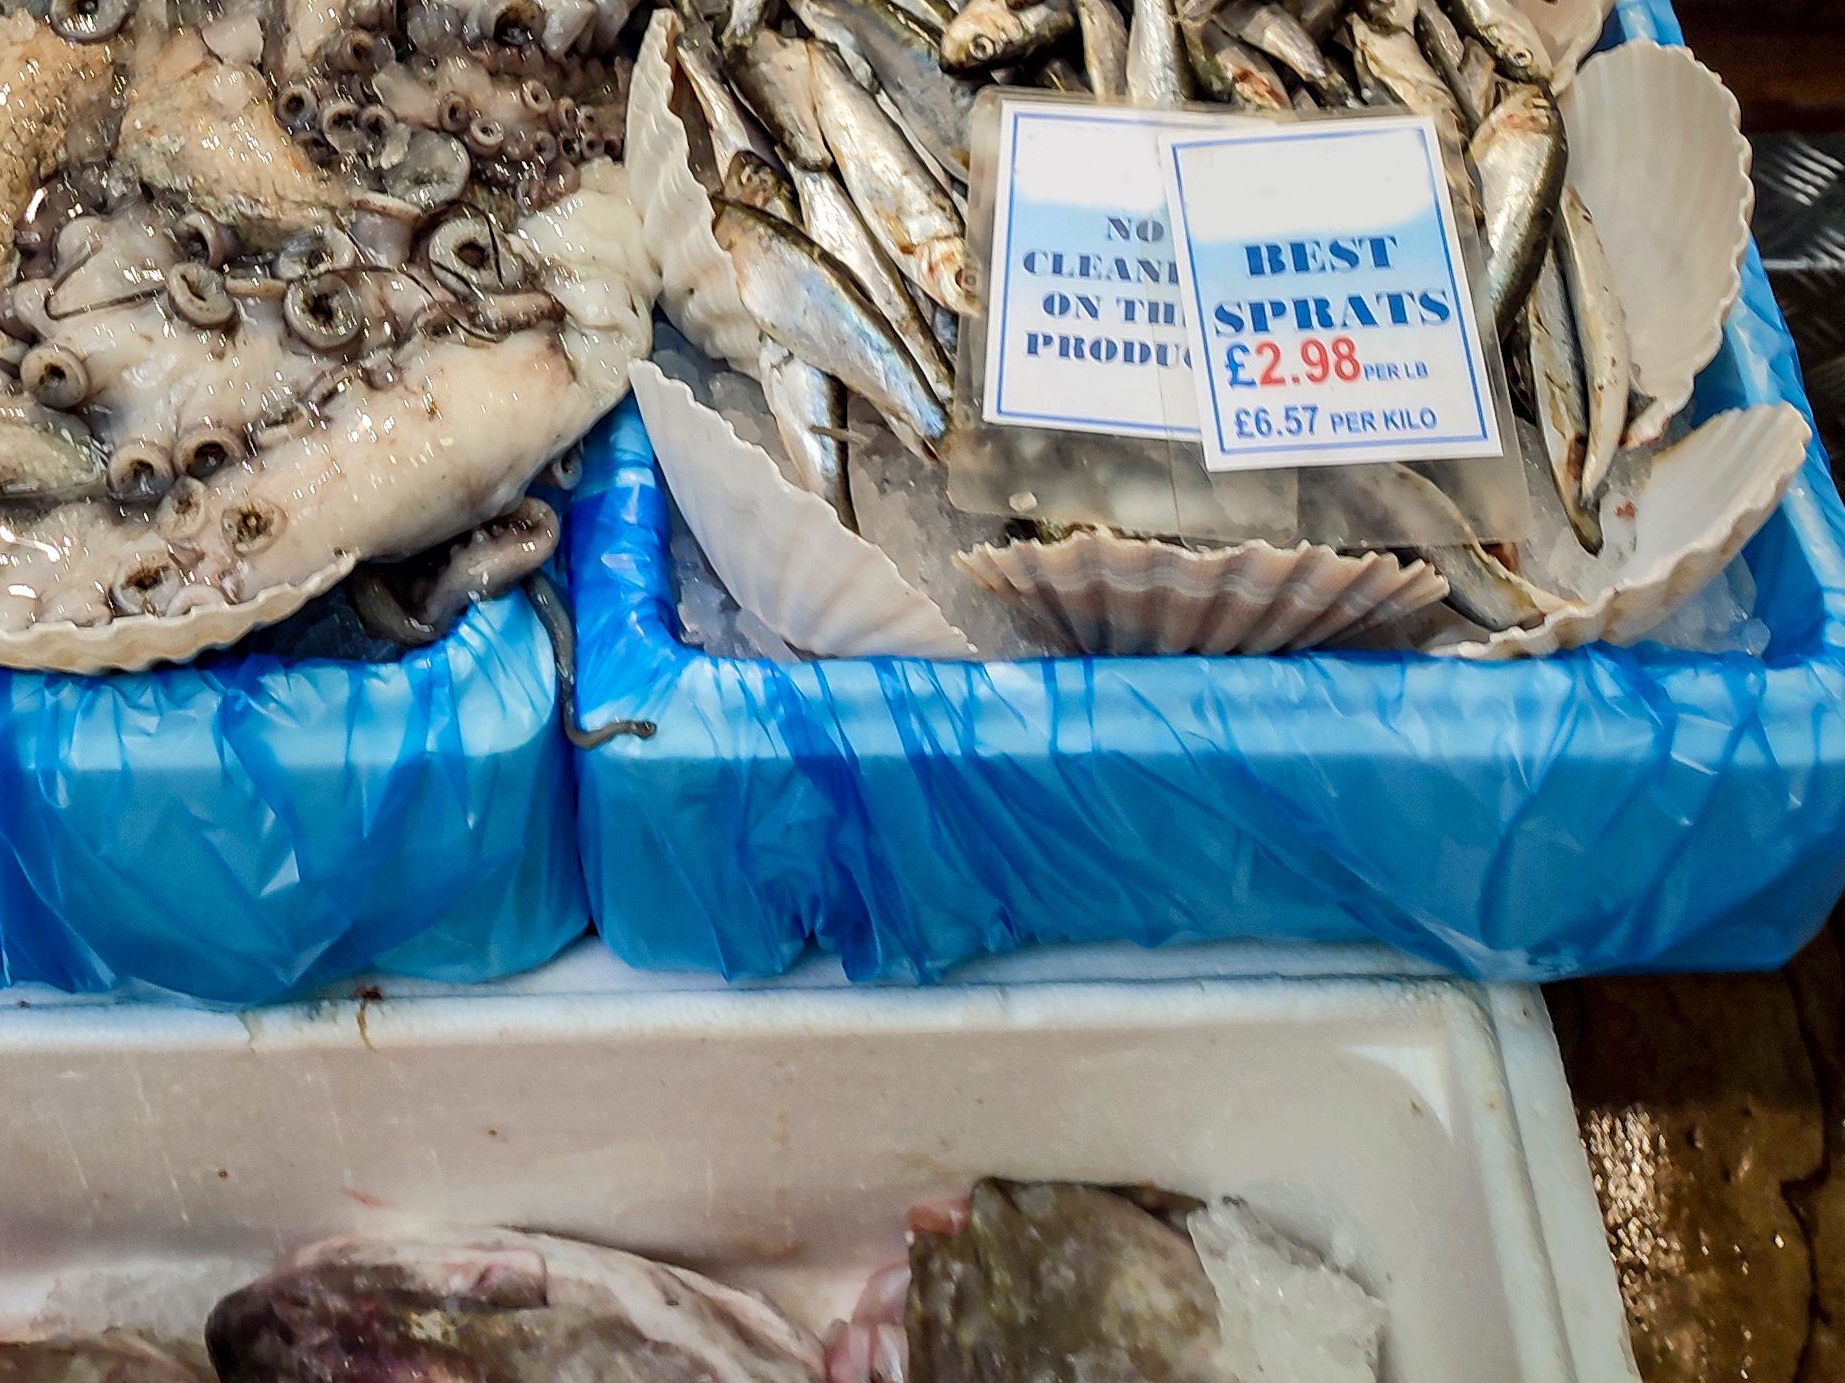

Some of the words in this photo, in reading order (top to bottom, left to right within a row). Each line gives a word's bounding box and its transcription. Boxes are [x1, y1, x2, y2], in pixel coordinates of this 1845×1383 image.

[1106, 216, 1164, 243] NO
[1244, 235, 1399, 276] BEST
[1042, 292, 1100, 319] ON
[1116, 295, 1187, 328] TH
[1214, 287, 1451, 338] SPRATS
[1225, 336, 1362, 389] £2.98
[1363, 363, 1403, 381] PER
[1405, 361, 1430, 379] LB
[1234, 404, 1320, 440] £6.57
[1329, 411, 1378, 433] PER
[1381, 407, 1438, 431] KILO
